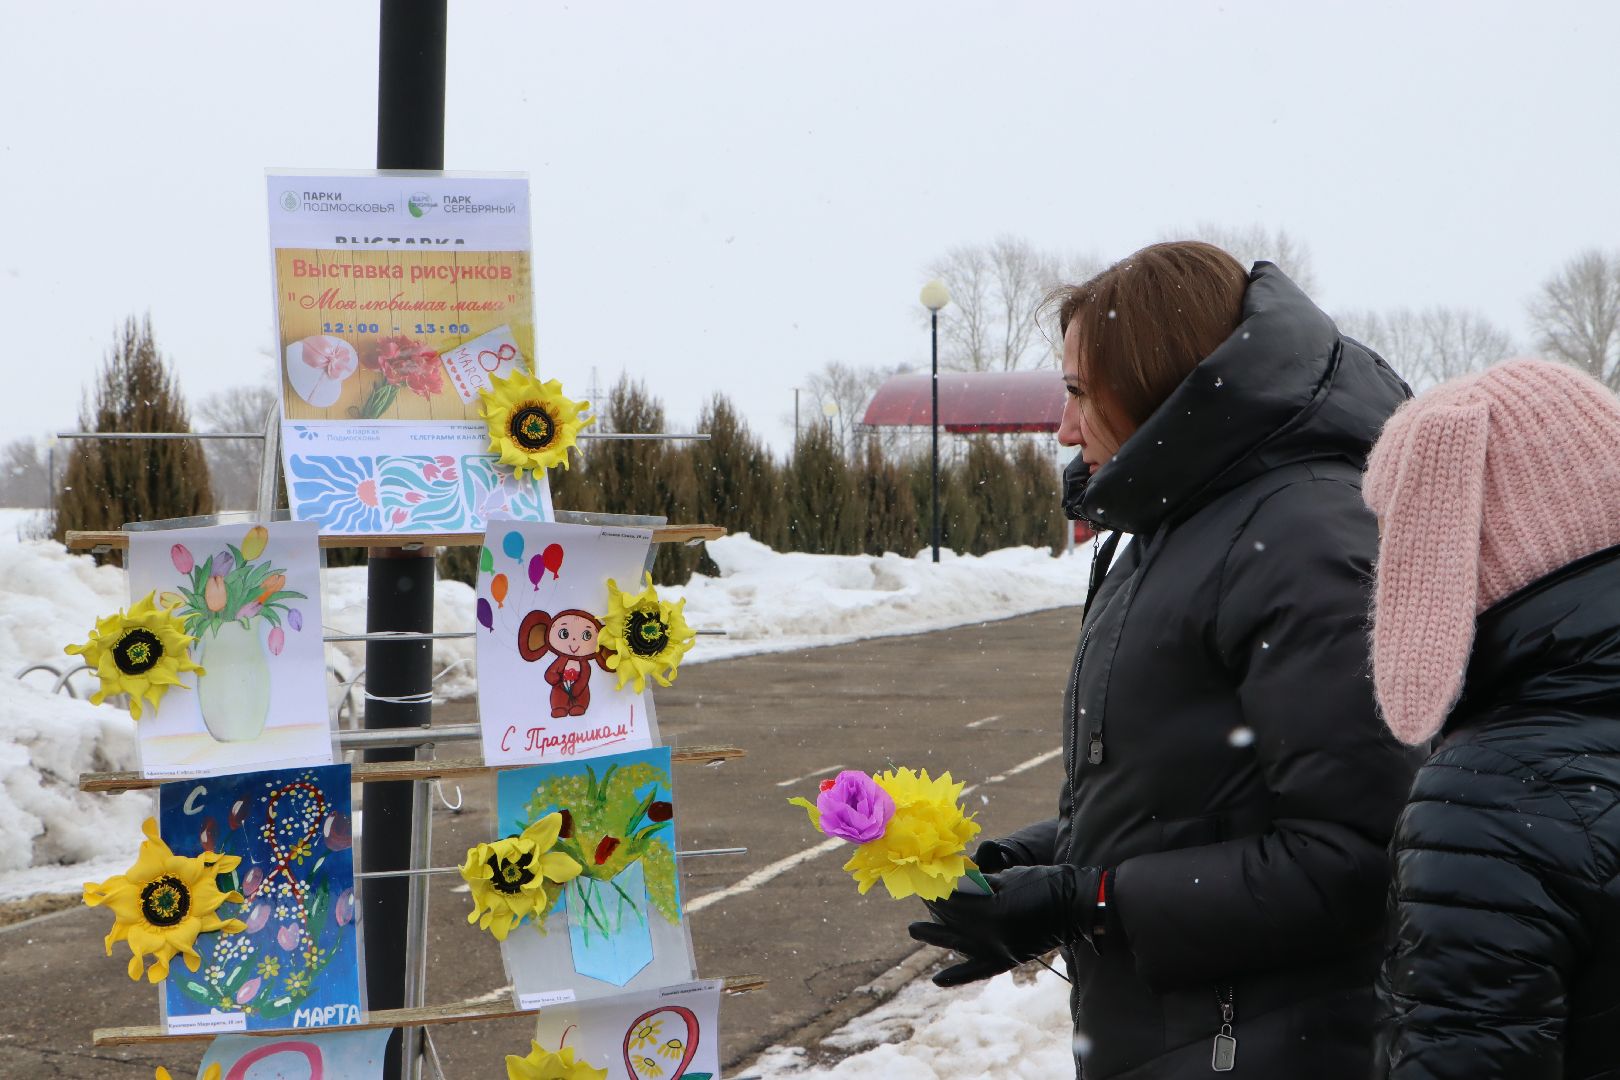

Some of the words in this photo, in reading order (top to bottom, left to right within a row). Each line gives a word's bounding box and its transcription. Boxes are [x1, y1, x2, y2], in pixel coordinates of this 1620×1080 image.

[303, 191, 342, 201] ПАРКИ
[443, 195, 472, 204] ПАРК
[303, 202, 395, 213] ПОДМОСКОВЬЯ
[443, 203, 516, 214] СЕРЕБРЯНЫЙ
[293, 258, 404, 279] Выставка
[410, 265, 513, 284] рисунков
[360, 291, 448, 311] любимая
[323, 322, 379, 333] 12:00
[415, 323, 470, 334] 13:00
[501, 725, 516, 751] С
[524, 703, 634, 757] Праздником!
[183, 785, 208, 815] С
[293, 1003, 361, 1028] МАРТА
